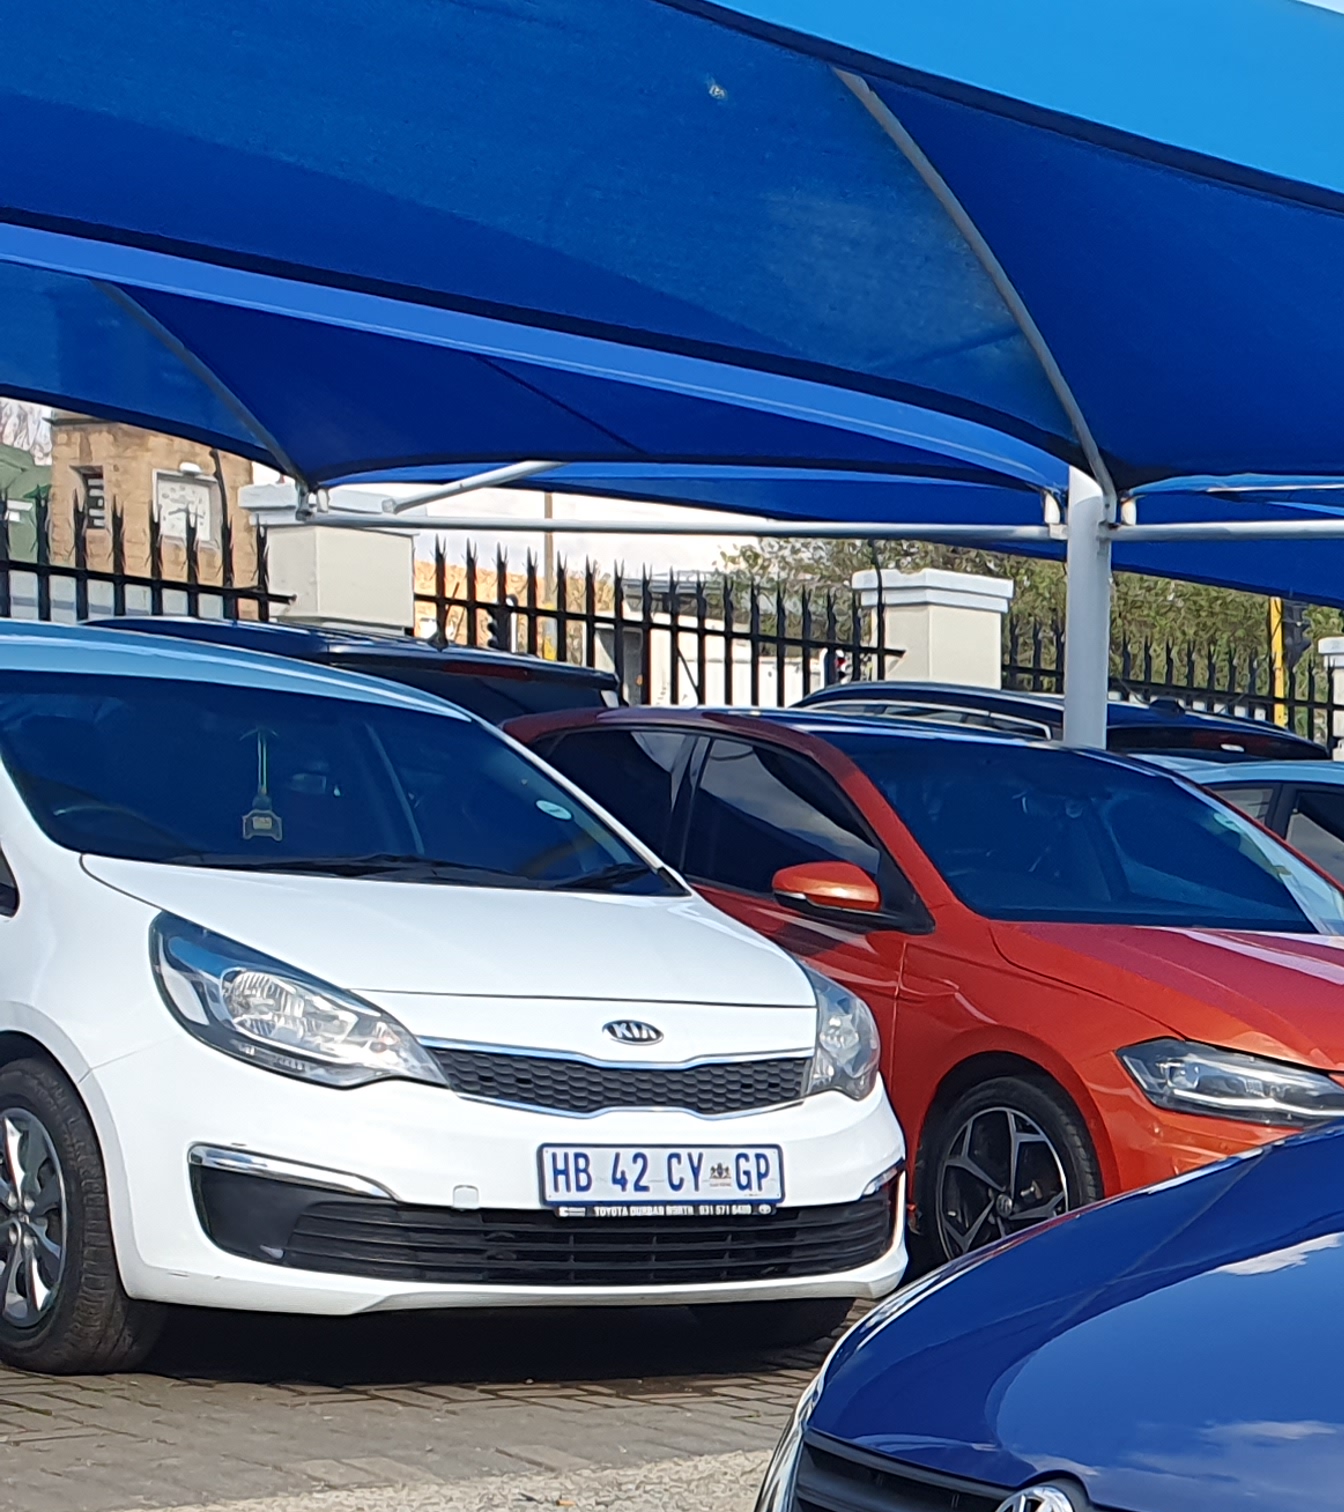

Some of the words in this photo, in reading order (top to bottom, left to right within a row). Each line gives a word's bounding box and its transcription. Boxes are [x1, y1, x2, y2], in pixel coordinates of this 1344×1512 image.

[611, 1021, 658, 1040] KIA
[551, 1150, 592, 1193] HB
[611, 1151, 650, 1193] 42
[666, 1151, 704, 1193] CY
[735, 1151, 772, 1192] GP
[593, 1206, 629, 1217] TOYOTA
